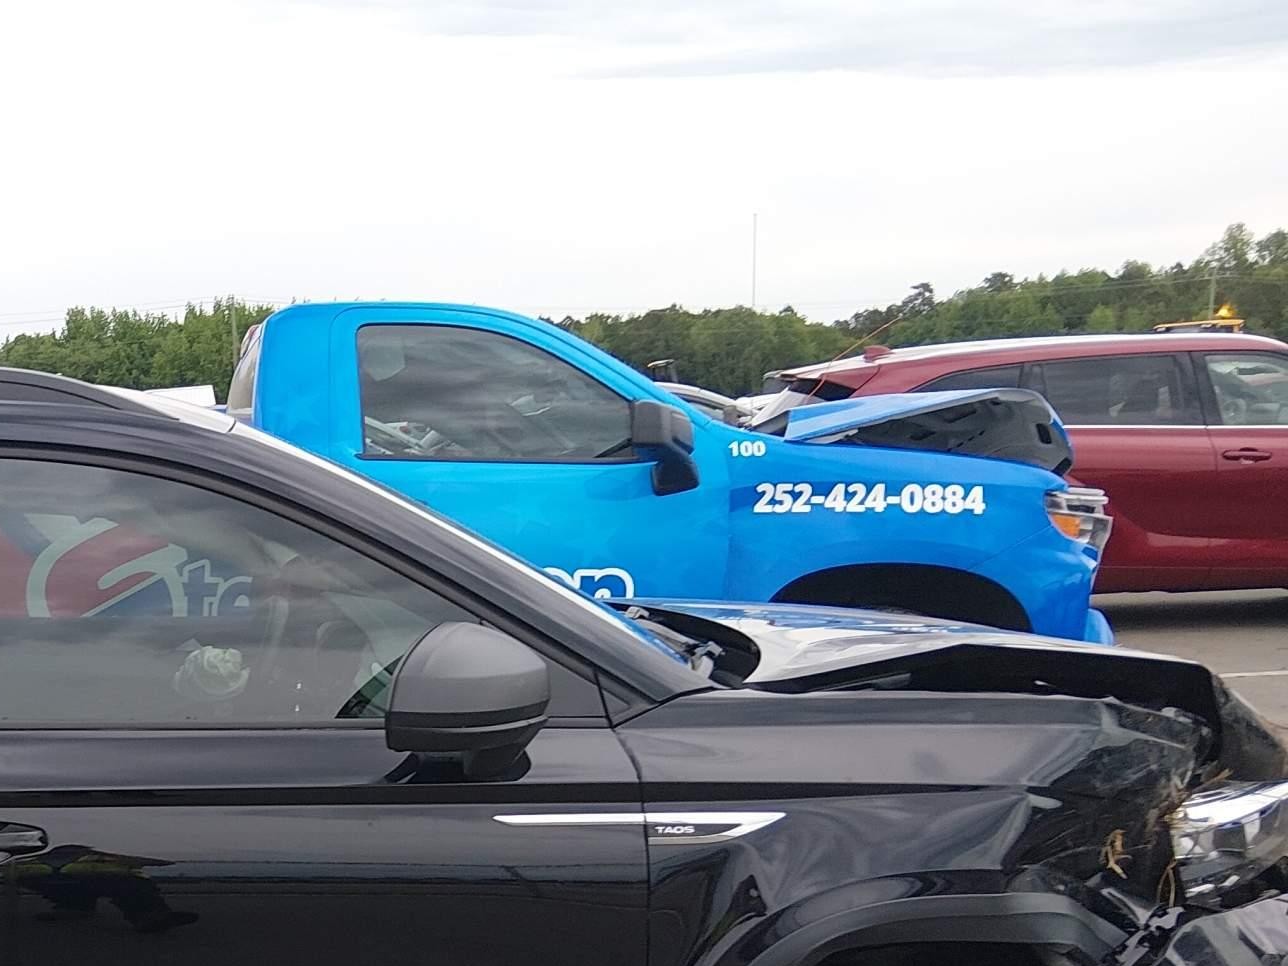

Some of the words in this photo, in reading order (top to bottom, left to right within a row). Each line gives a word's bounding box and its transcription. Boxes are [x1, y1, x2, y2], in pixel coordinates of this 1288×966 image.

[728, 441, 766, 457] 100
[753, 483, 986, 514] 252-424-0884
[654, 825, 695, 834] TAOS
